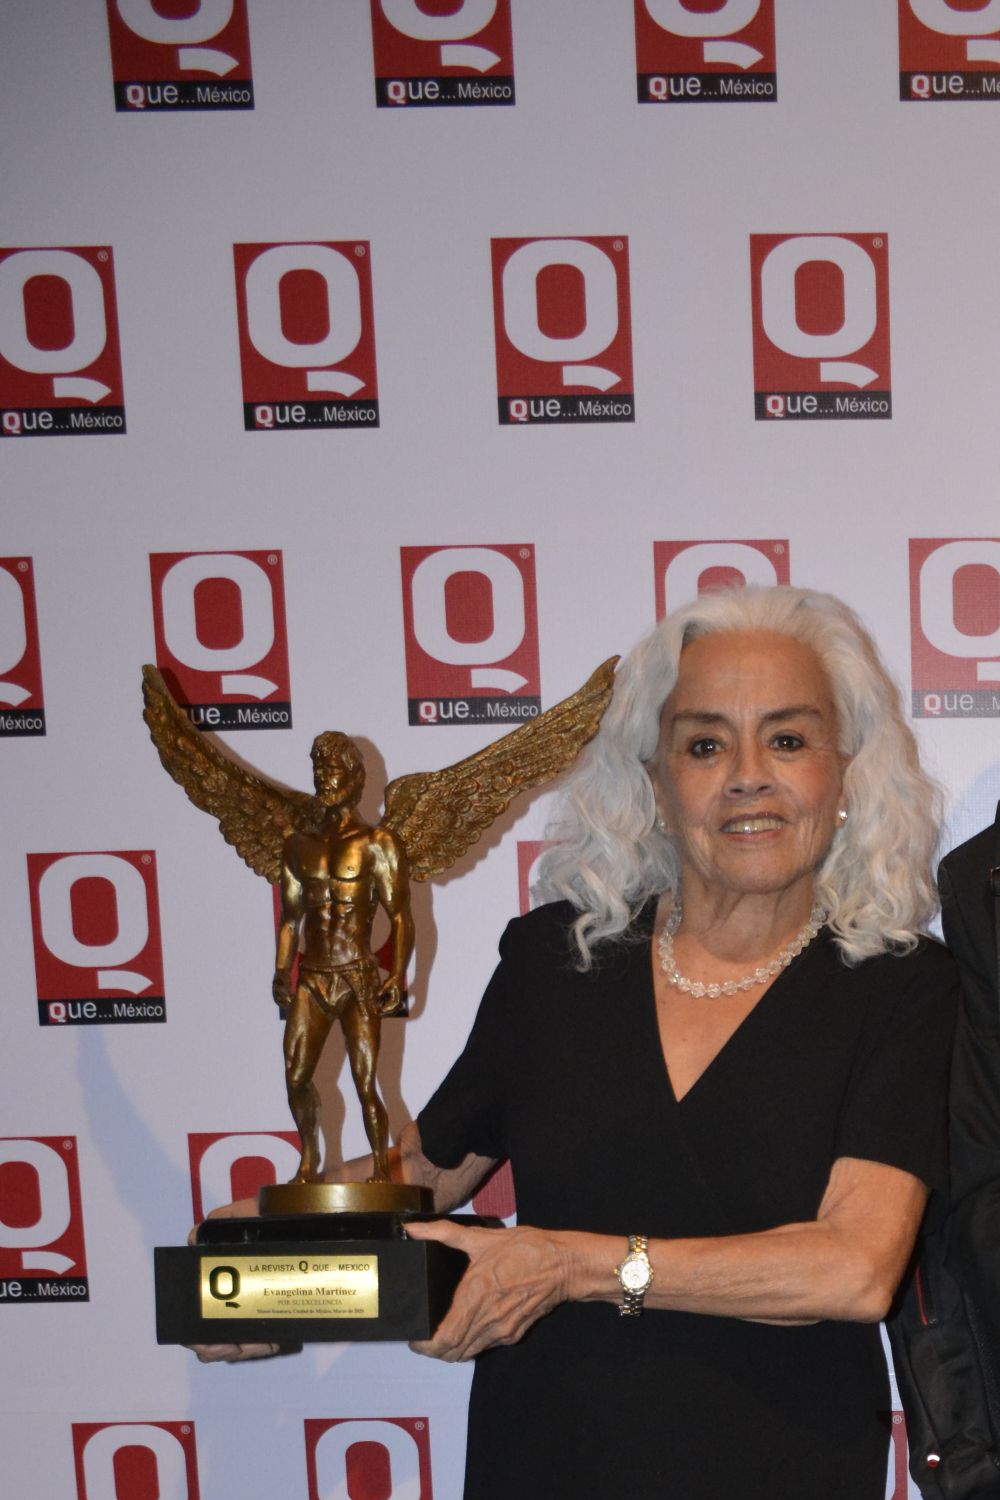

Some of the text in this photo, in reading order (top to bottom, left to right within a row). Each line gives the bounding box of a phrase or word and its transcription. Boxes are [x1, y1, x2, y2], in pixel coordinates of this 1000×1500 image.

[0, 250, 112, 403] Q
[246, 245, 365, 397] Q
[503, 240, 621, 391] Q
[761, 236, 878, 388] Q
[162, 554, 278, 699] Q
[412, 548, 528, 693] Q
[39, 854, 153, 994] Q
[209, 1265, 241, 1308] Q
[249, 1264, 260, 1273] LA
[262, 1264, 295, 1272] REVISTA
[298, 1260, 309, 1273] Q
[264, 1288, 313, 1297] Evangelina
